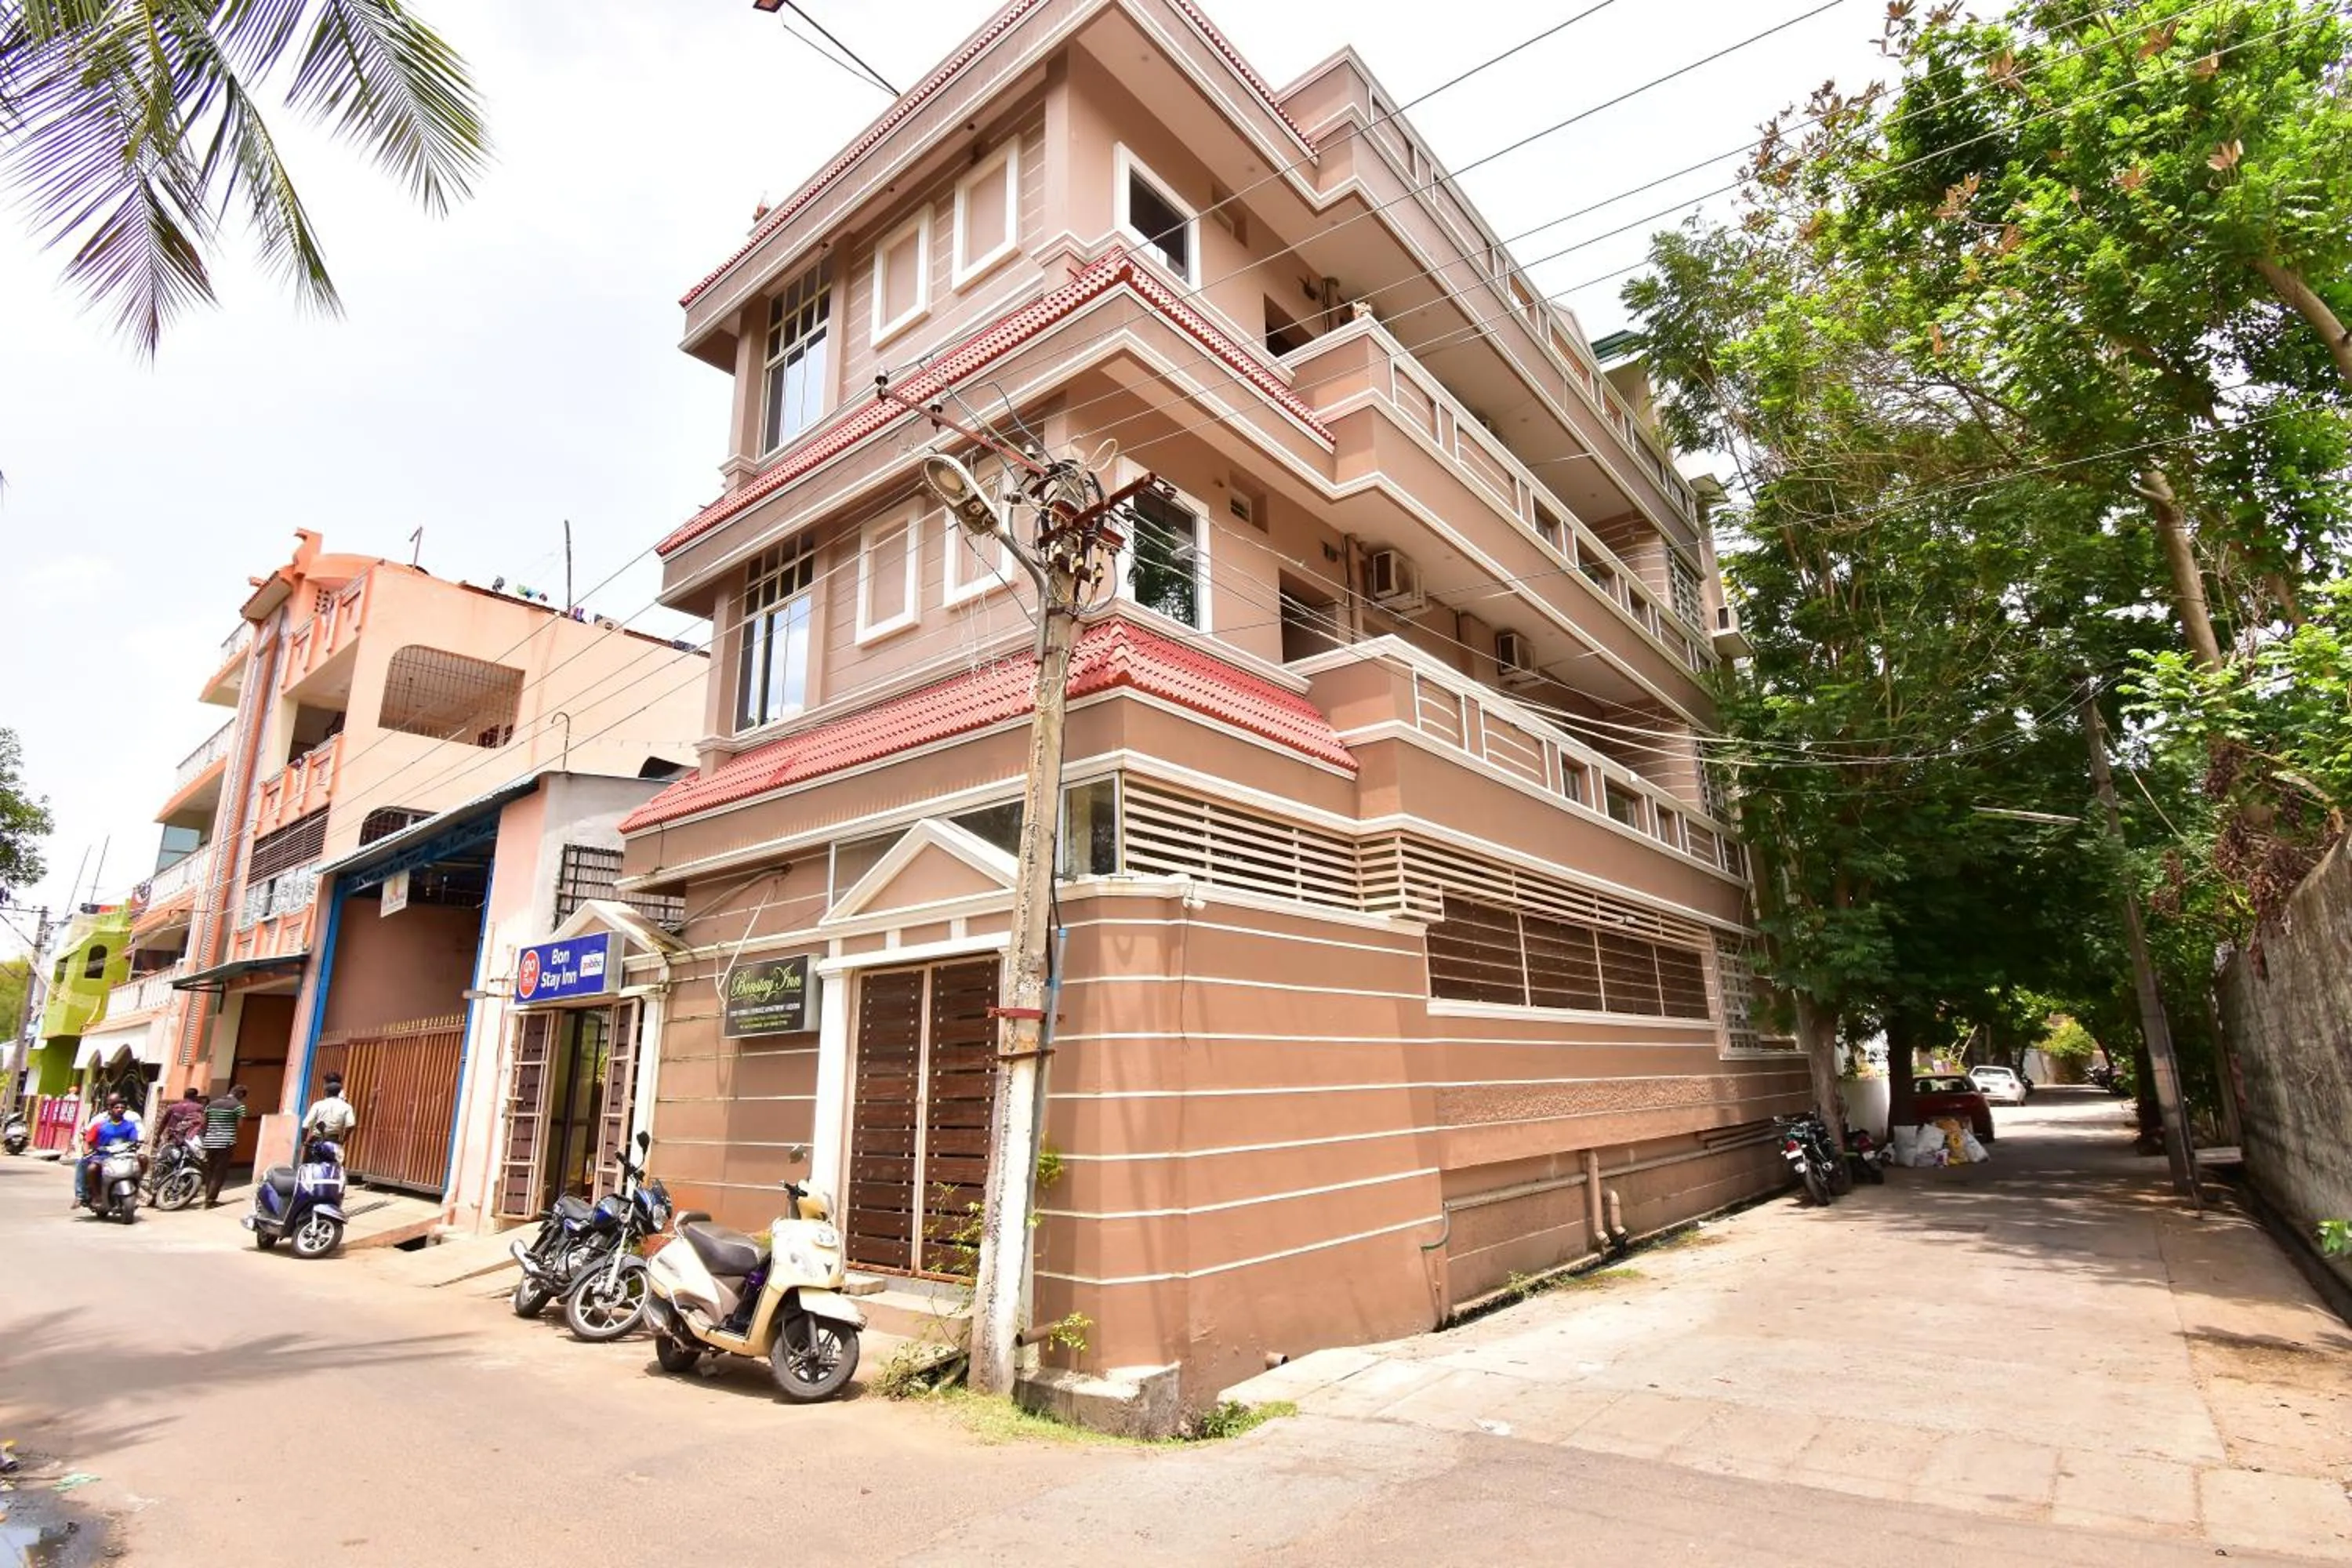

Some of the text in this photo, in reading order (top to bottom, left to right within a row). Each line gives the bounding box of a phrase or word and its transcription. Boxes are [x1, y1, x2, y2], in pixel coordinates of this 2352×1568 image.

[552, 948, 569, 964] Bon
[541, 971, 561, 991] Stay
[561, 964, 577, 985] Inn
[774, 963, 800, 989] Inn
